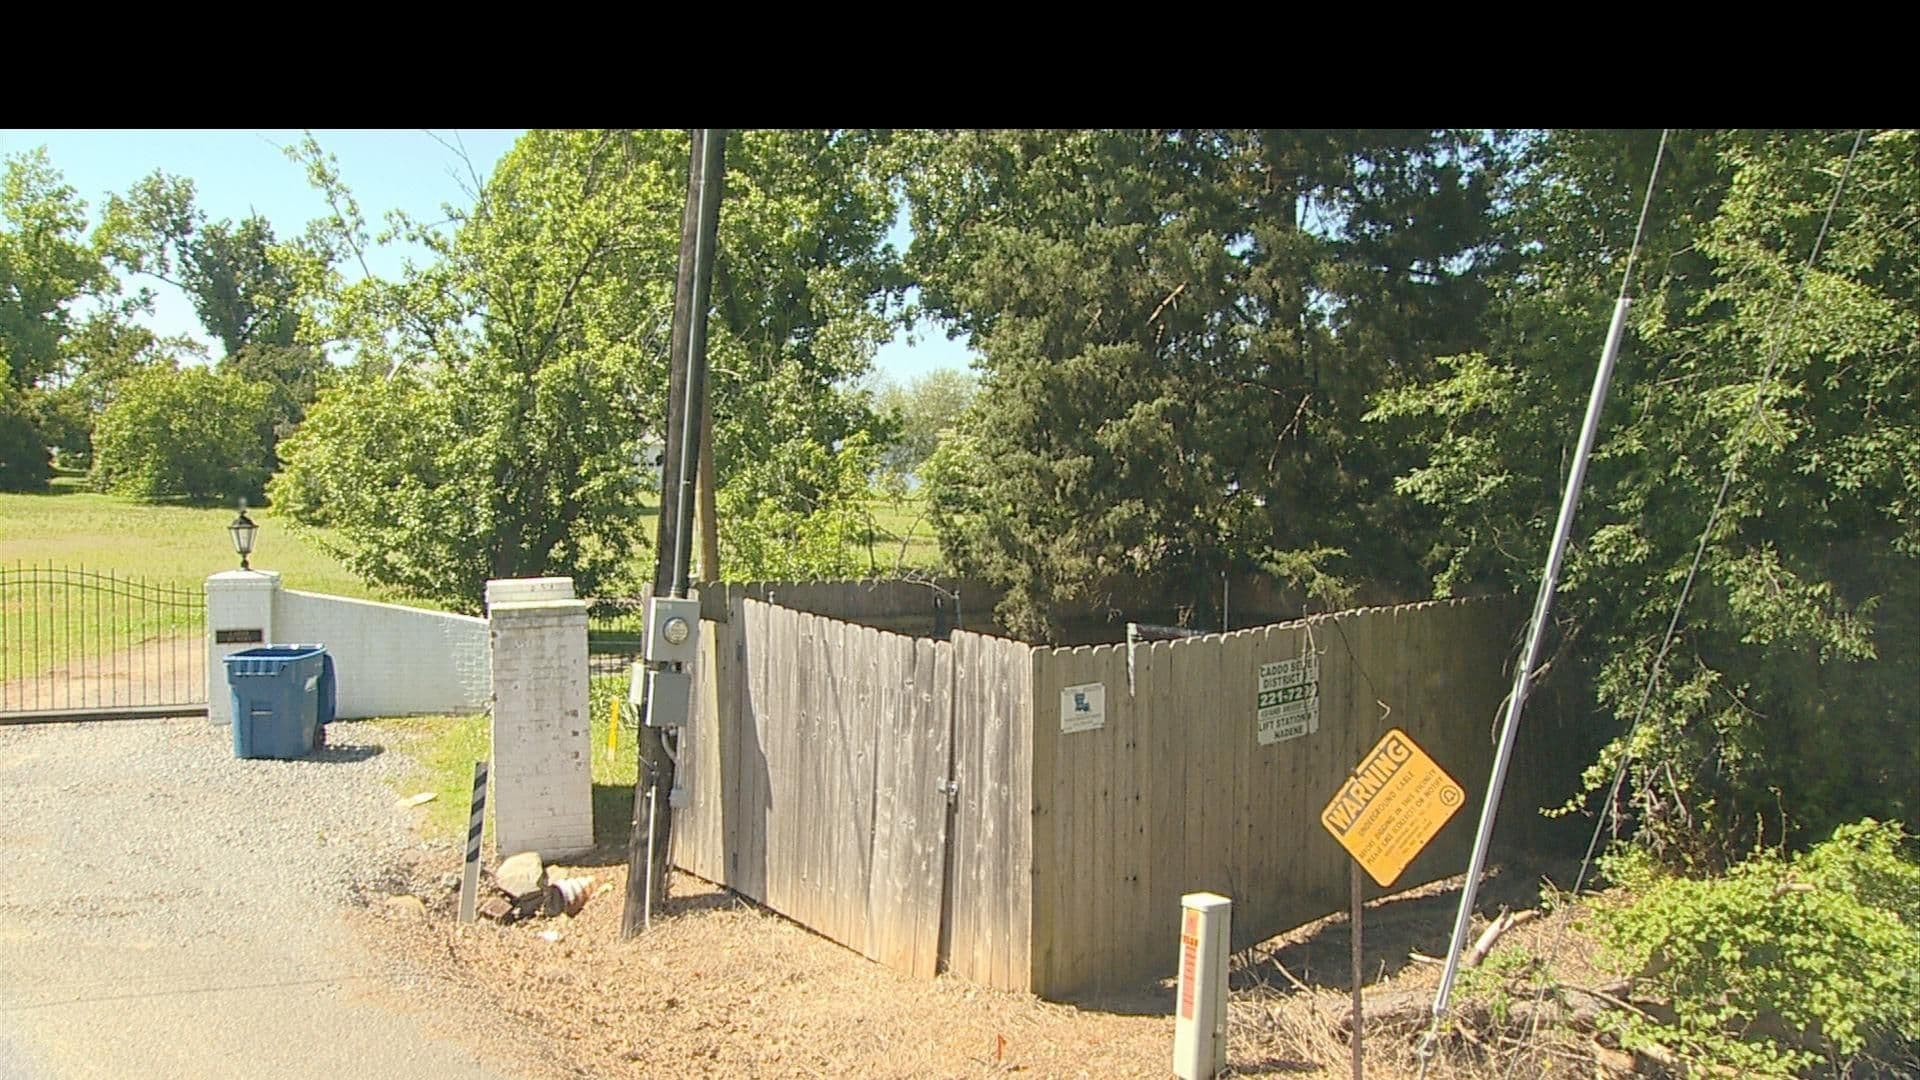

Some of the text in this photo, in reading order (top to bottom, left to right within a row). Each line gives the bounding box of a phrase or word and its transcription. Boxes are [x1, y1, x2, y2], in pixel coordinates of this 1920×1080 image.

[1260, 663, 1289, 678] CADDO
[1263, 673, 1301, 689] DISTRICT
[1327, 736, 1411, 831] WARNING
